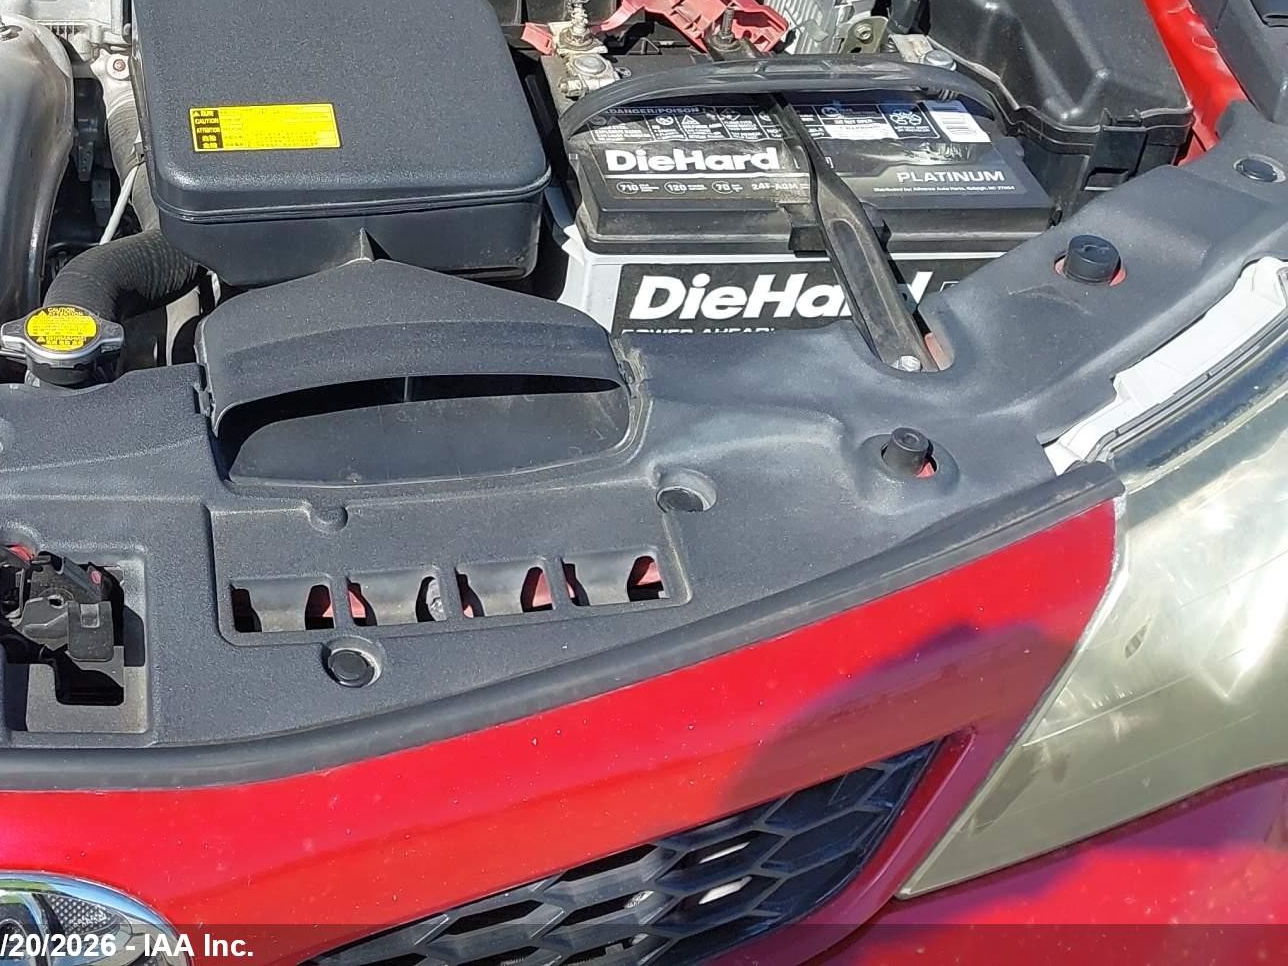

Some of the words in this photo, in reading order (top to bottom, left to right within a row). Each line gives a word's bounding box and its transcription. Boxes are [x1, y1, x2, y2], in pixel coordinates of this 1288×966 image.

[604, 146, 780, 172] DieHard
[896, 170, 1005, 183] PLATINUM
[716, 183, 732, 191] 70
